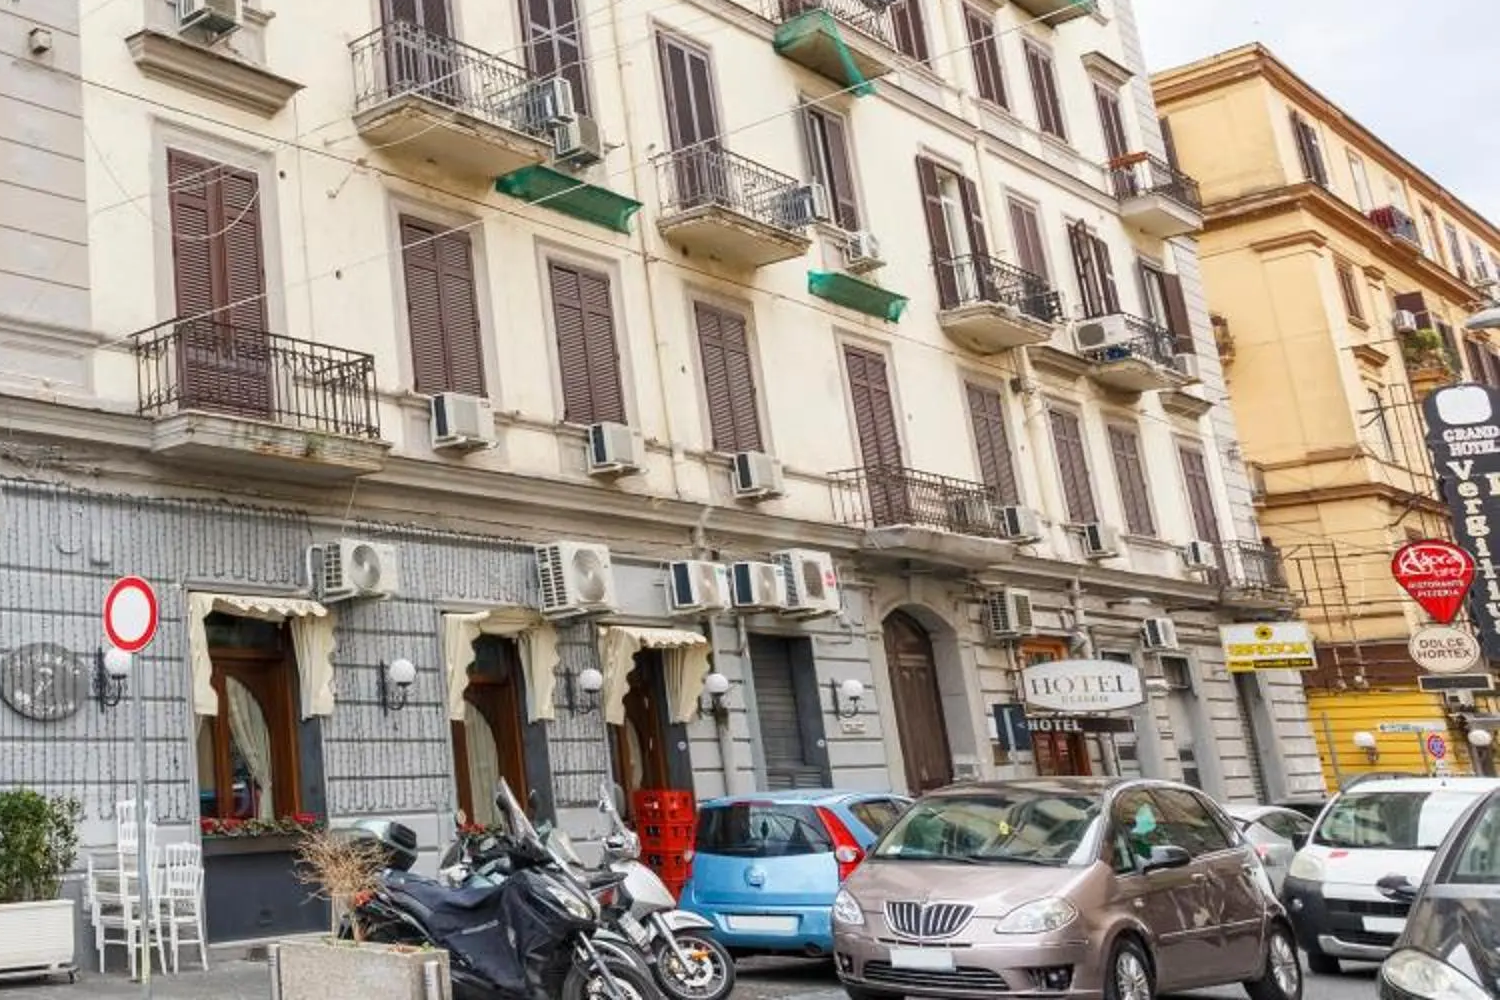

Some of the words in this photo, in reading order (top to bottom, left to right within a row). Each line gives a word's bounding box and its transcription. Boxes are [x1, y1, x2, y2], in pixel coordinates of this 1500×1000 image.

[1442, 425, 1500, 442] GRAND
[1448, 439, 1500, 457] HOTEL
[1419, 637, 1464, 649] DOLCE
[1031, 674, 1134, 695] HOTEL
[1027, 719, 1083, 732] HOTEL
